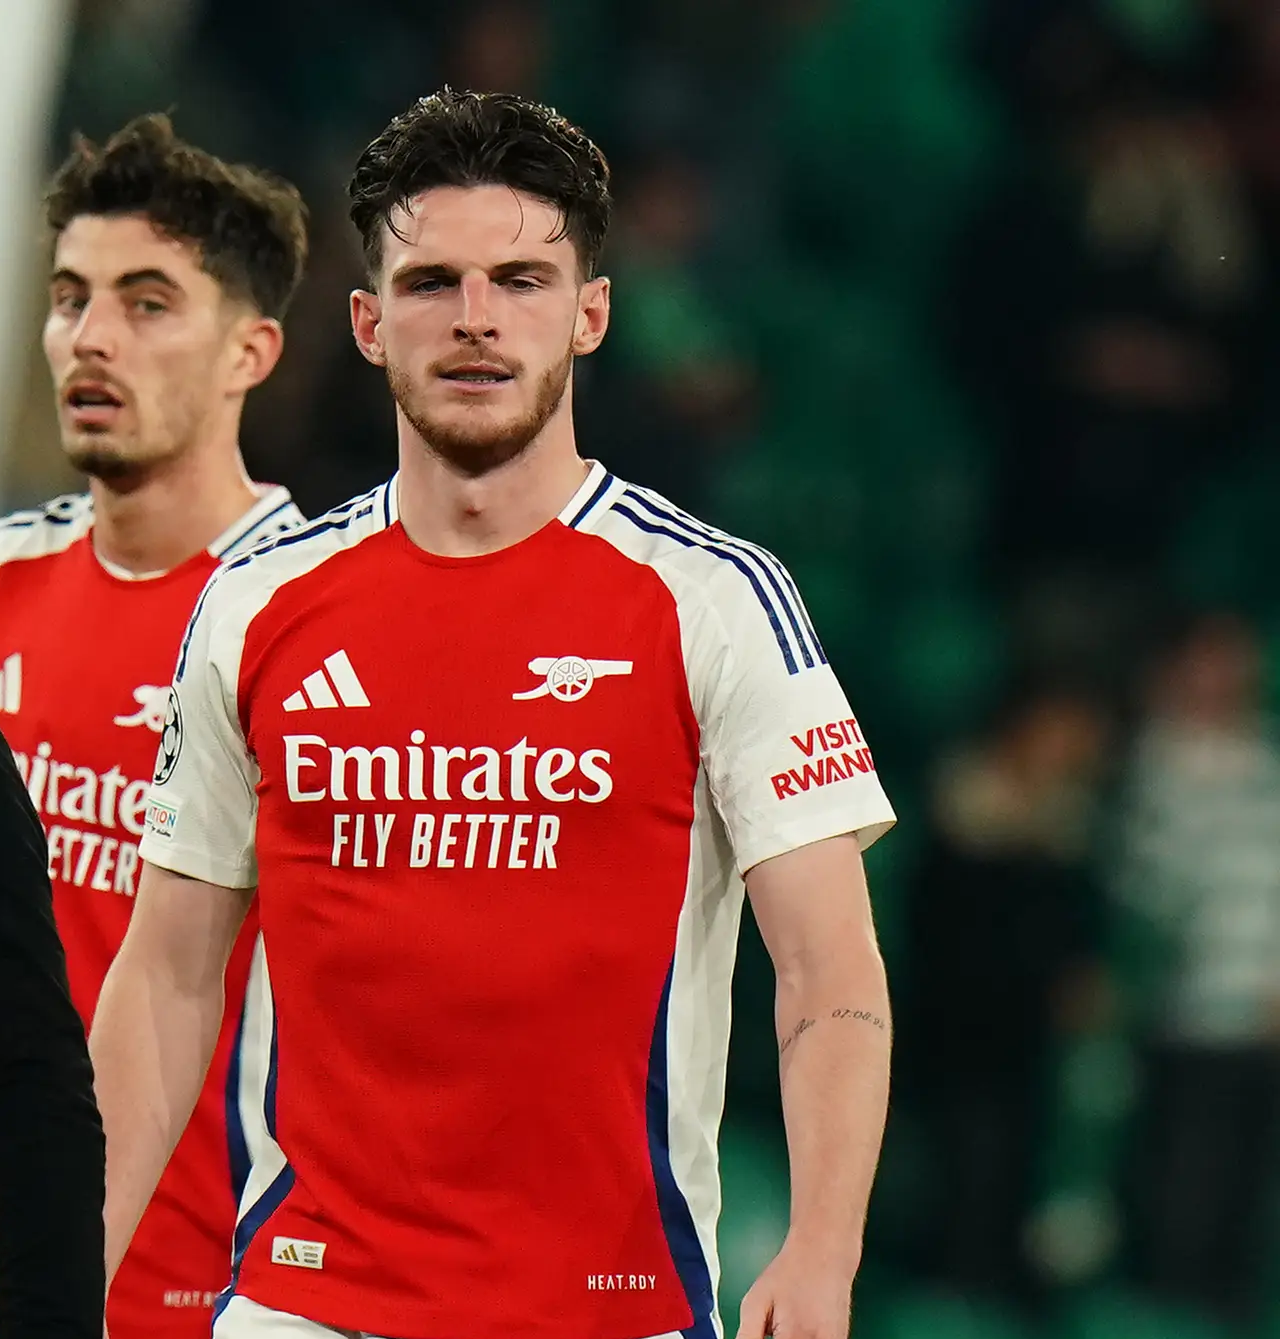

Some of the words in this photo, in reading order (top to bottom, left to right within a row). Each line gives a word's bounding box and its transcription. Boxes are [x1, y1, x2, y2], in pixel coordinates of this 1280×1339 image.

[790, 718, 861, 757] VISIT
[12, 741, 151, 836] irate
[282, 729, 614, 803] Emirates
[770, 747, 875, 800] RWAN
[42, 824, 139, 897] ETTER
[331, 814, 396, 868] FLY
[409, 814, 561, 869] BETTER
[587, 1274, 656, 1290] HEAT.RDY
